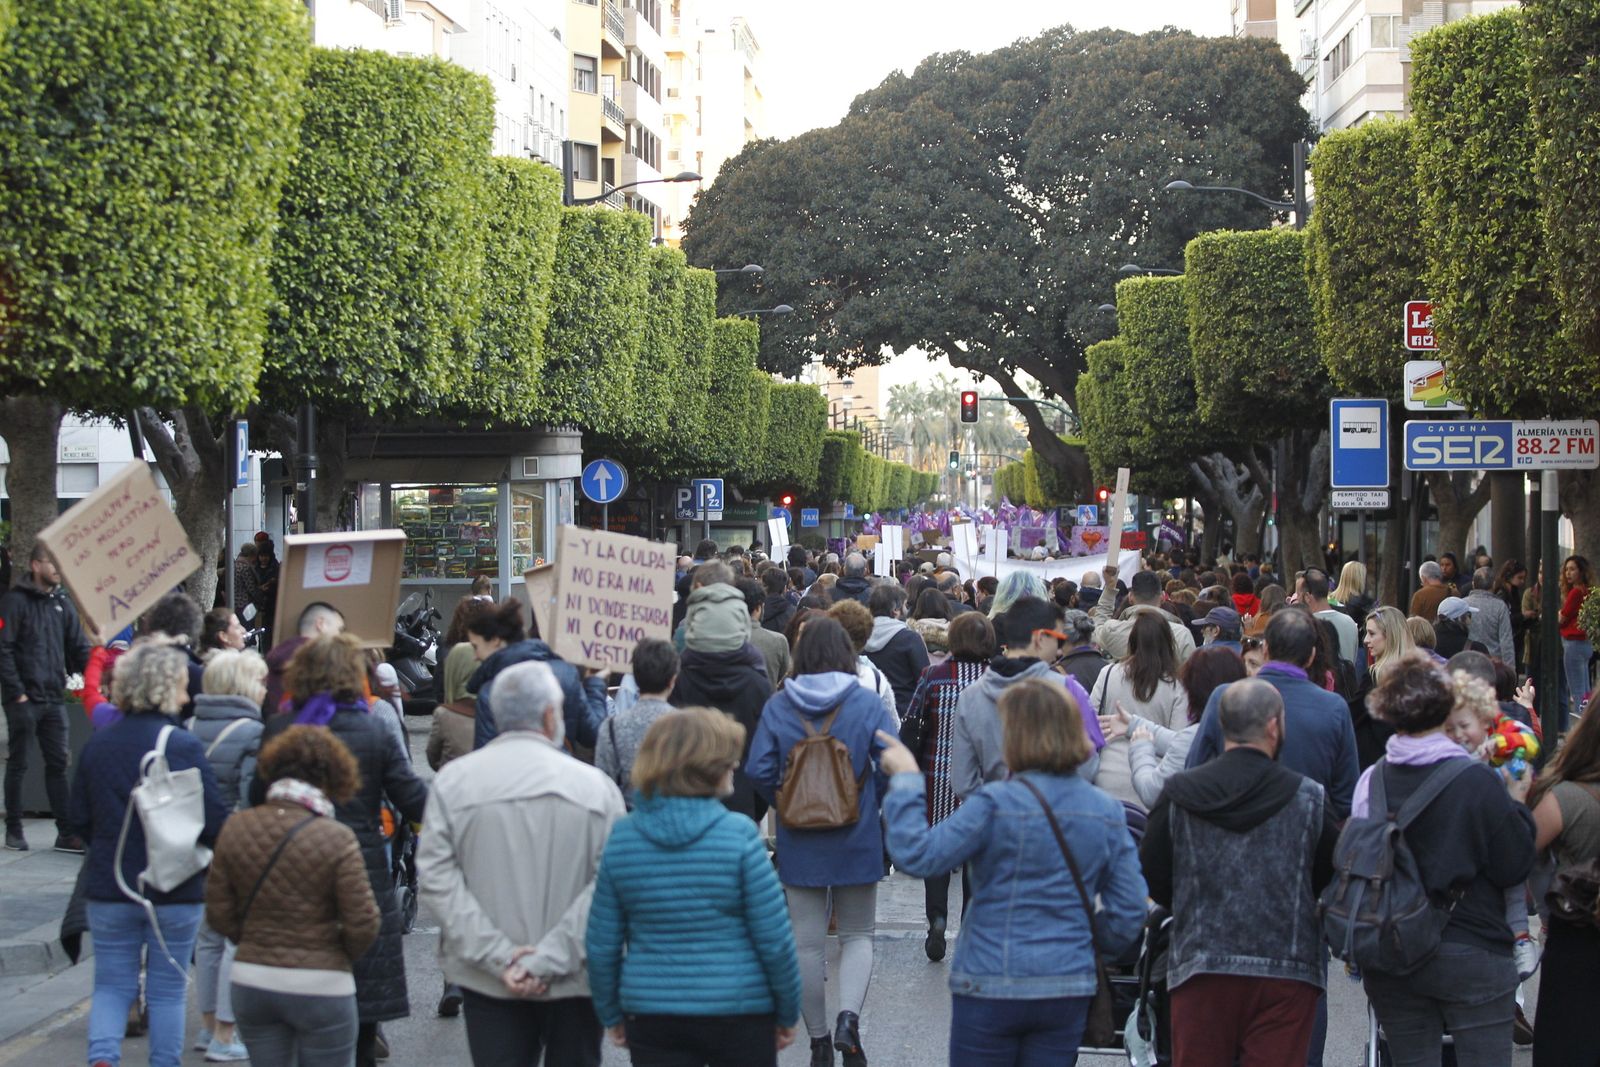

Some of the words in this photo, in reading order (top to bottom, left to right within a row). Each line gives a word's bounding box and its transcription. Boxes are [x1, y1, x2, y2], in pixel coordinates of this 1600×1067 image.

[1517, 427, 1555, 436] ALMERÍA
[1557, 428, 1568, 436] YA
[1570, 428, 1581, 436] EN
[1584, 428, 1594, 436] EL
[1412, 435, 1505, 465] SER
[1517, 438, 1560, 455] 88.2
[1567, 438, 1594, 455] FM
[677, 488, 692, 508] P
[701, 483, 716, 507] P
[708, 499, 720, 507] Z2
[597, 542, 616, 560] LA
[572, 566, 593, 586] NO
[597, 570, 624, 590] ERA
[566, 592, 581, 610] NI
[588, 597, 629, 619] DONDE
[631, 604, 669, 627] ESTABA
[566, 618, 580, 634] NI
[593, 620, 645, 642] COMO
[580, 640, 634, 665] VESTI
